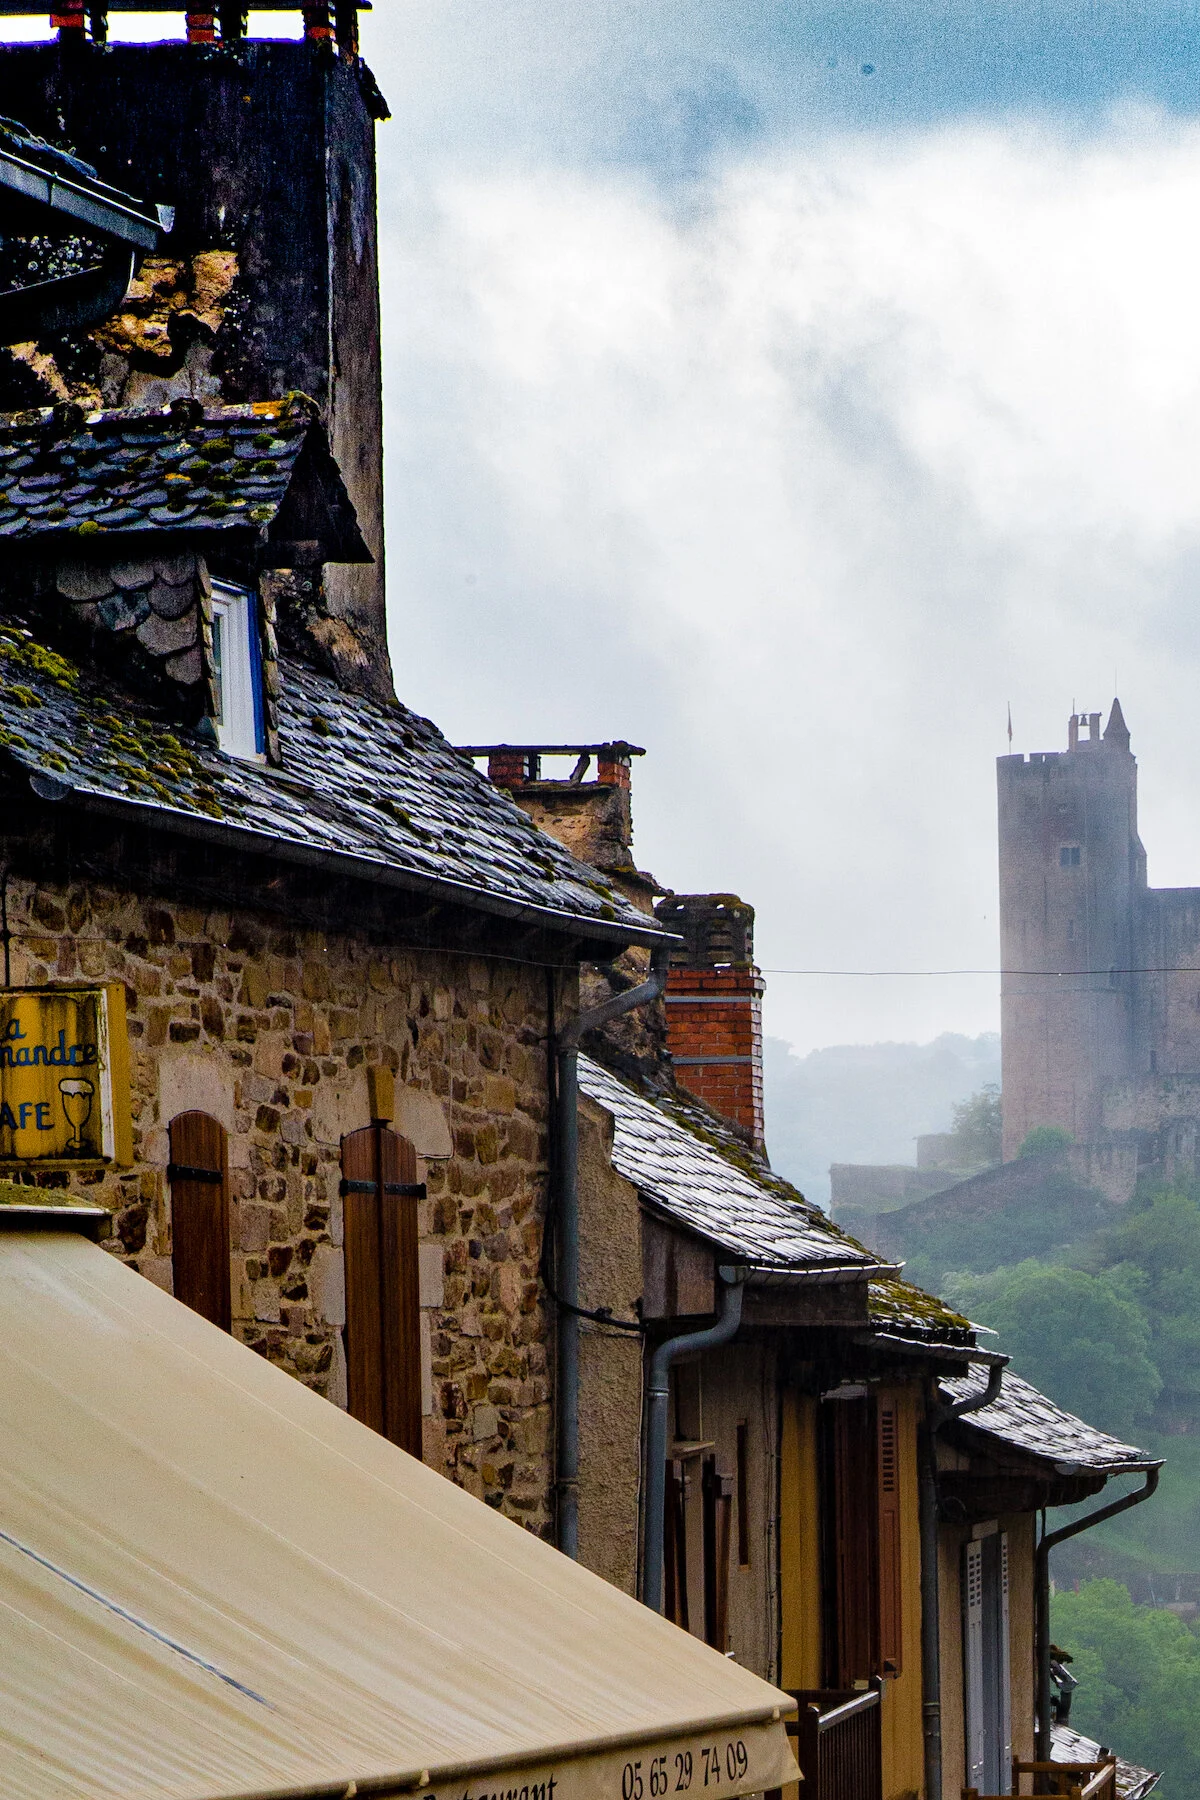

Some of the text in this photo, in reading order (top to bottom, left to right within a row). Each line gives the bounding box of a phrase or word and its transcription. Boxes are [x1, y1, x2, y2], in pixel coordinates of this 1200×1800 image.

[649, 1755, 668, 1798] 65
[675, 1750, 693, 1792] 29
[702, 1745, 721, 1787] 74
[726, 1740, 748, 1780] 09
